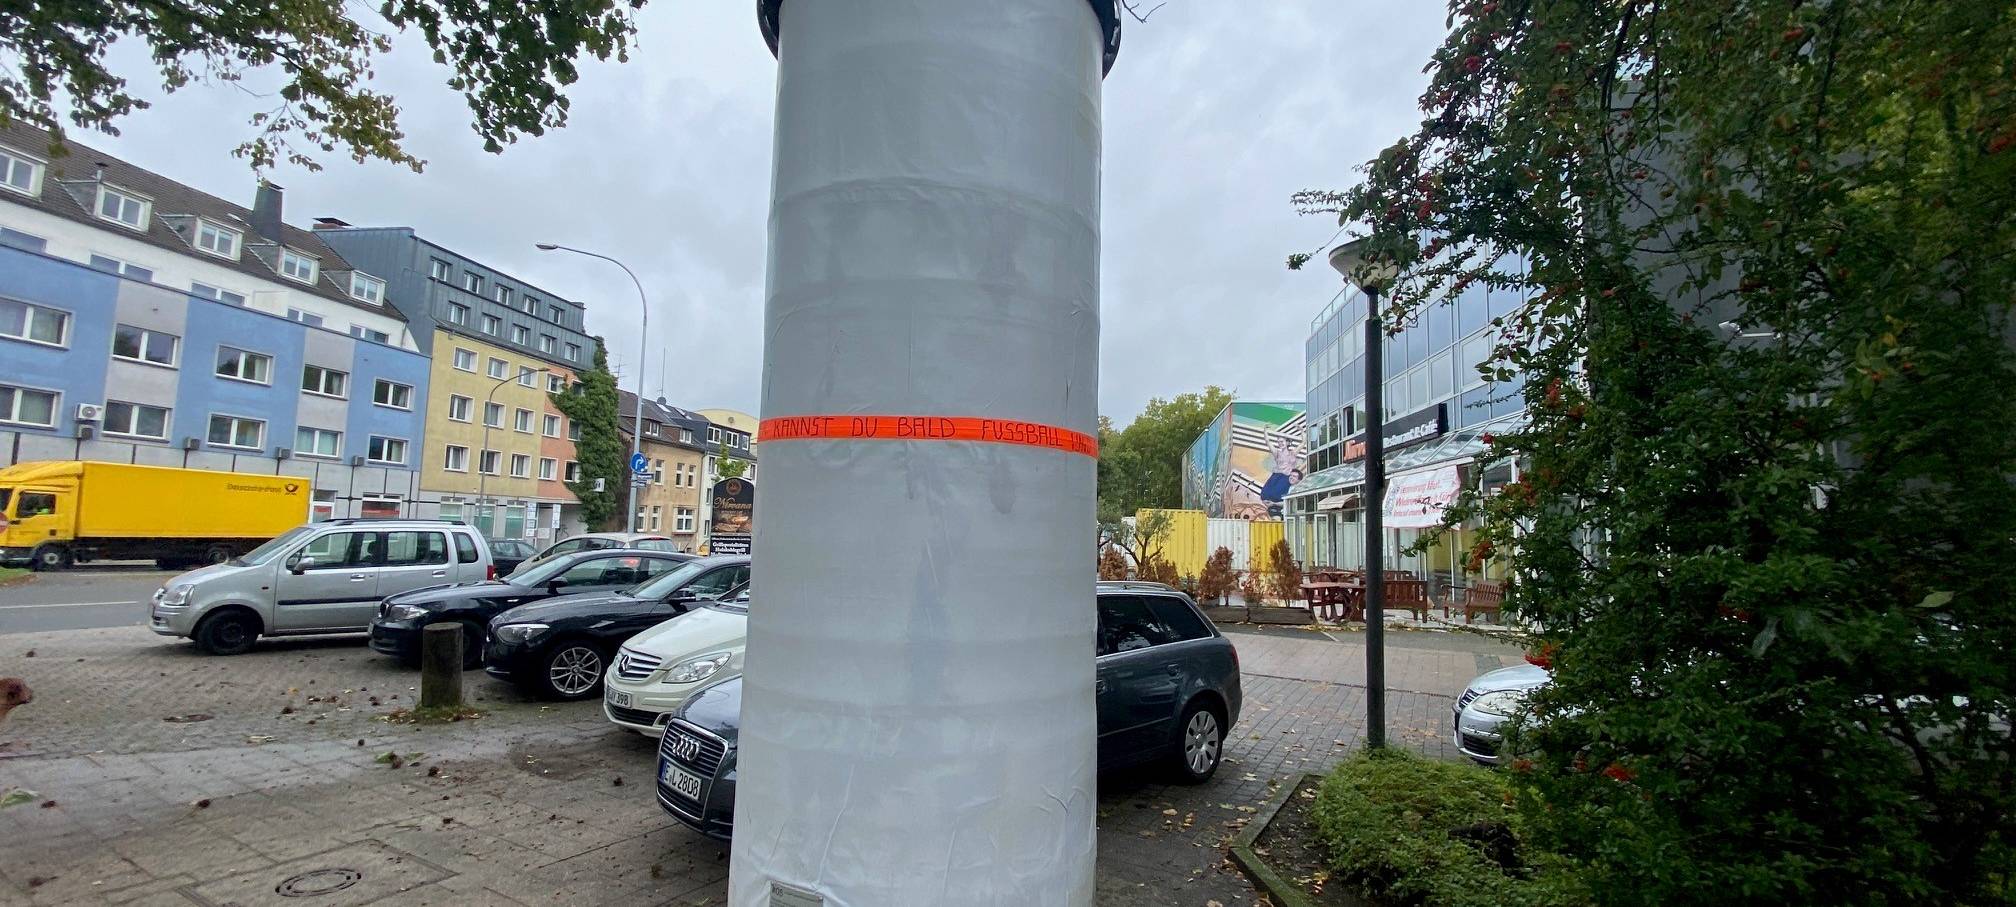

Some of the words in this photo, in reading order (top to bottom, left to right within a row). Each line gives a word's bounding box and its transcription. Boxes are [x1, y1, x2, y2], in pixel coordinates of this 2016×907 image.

[774, 416, 835, 438] KANNST
[851, 417, 878, 438] DU
[897, 416, 956, 438] BALD
[981, 419, 1063, 447] FUSSBALL
